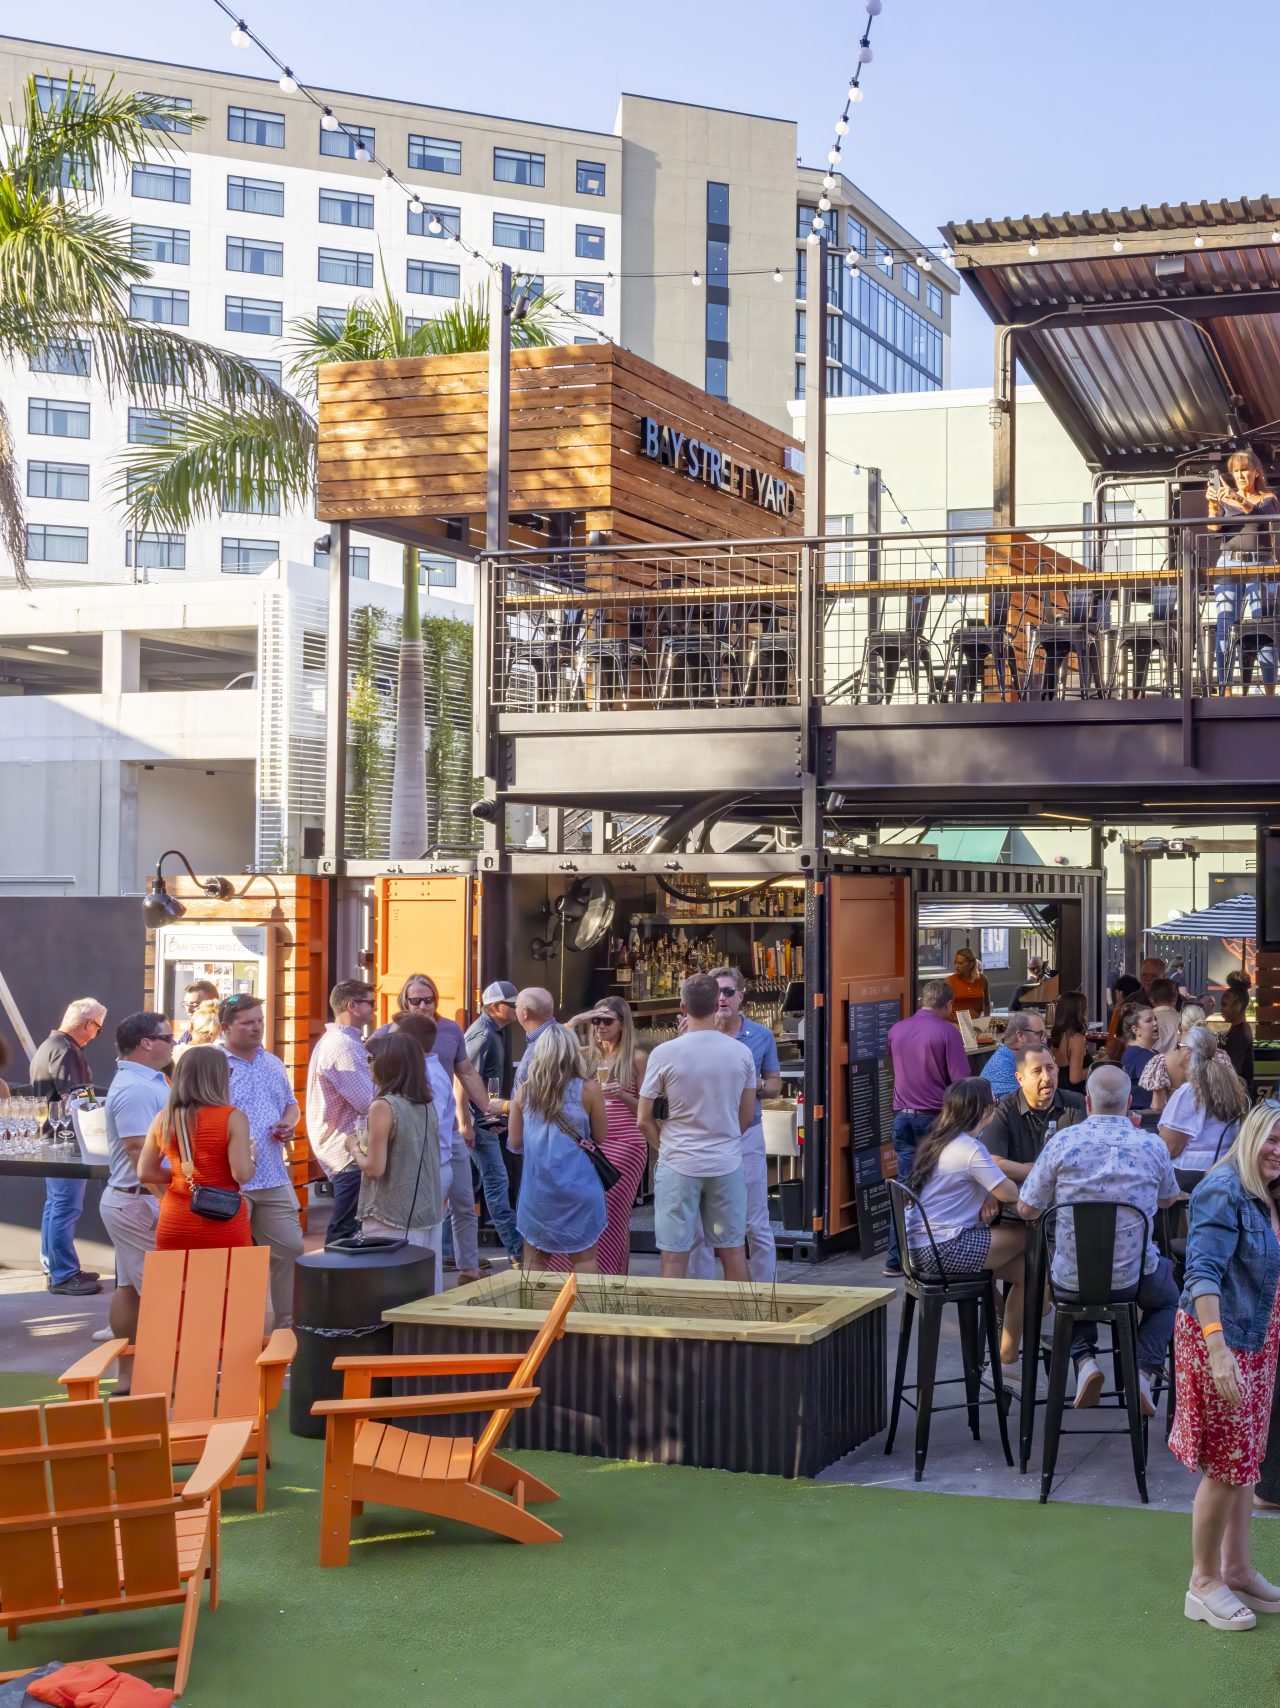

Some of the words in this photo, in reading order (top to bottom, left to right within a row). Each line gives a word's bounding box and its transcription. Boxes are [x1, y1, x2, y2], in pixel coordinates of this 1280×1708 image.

[641, 416, 684, 469] BAY
[688, 438, 751, 499] STREET
[755, 469, 797, 518] YARD
